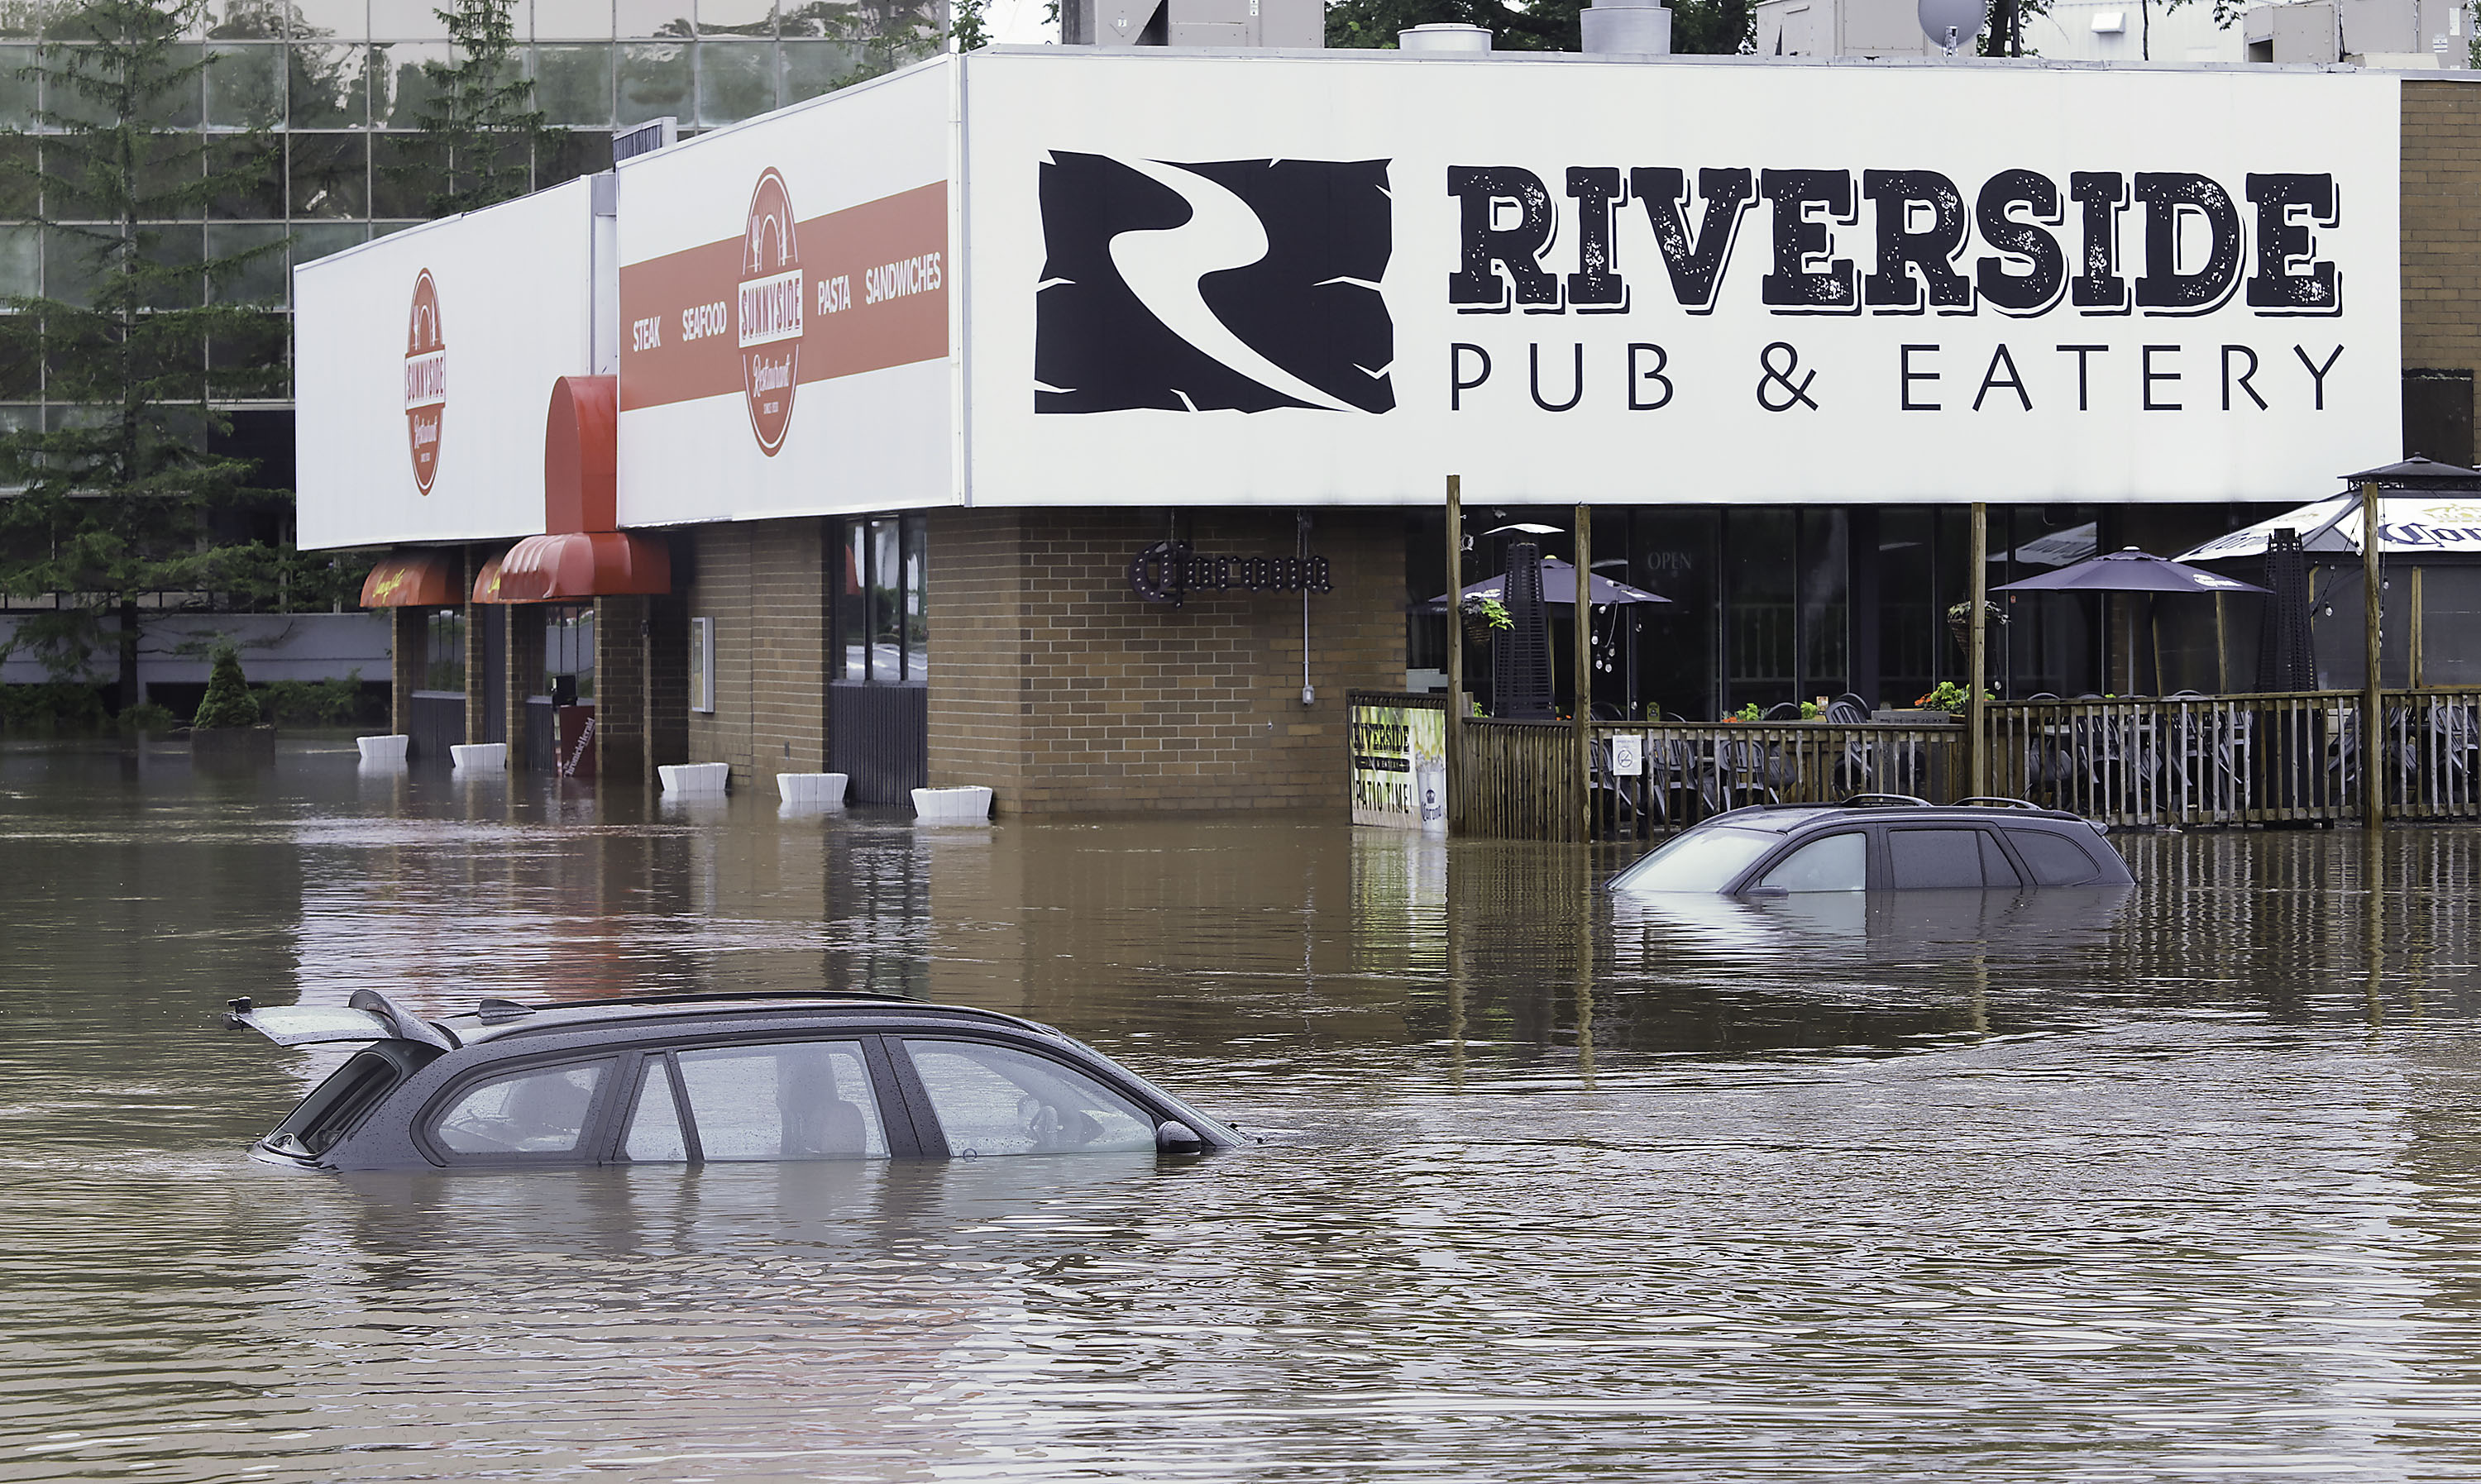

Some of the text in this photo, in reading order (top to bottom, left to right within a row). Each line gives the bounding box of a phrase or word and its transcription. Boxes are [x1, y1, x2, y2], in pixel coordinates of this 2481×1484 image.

[1447, 165, 2342, 318] RIVERSIDE
[817, 274, 851, 316] PASTA
[865, 251, 941, 304] SANDWICHES
[681, 301, 727, 341] SEAFOOD
[741, 277, 801, 340] SUNNYSIDE
[633, 315, 661, 352] STEAK
[406, 355, 444, 403] SUNNYSIDE
[1451, 341, 2345, 413] PUB & EATERY
[1128, 540, 1335, 608] Corona
[1647, 551, 1692, 570] OPEN
[1353, 723, 1410, 754] RIVERSIDE
[1355, 780, 1383, 812] PATIO
